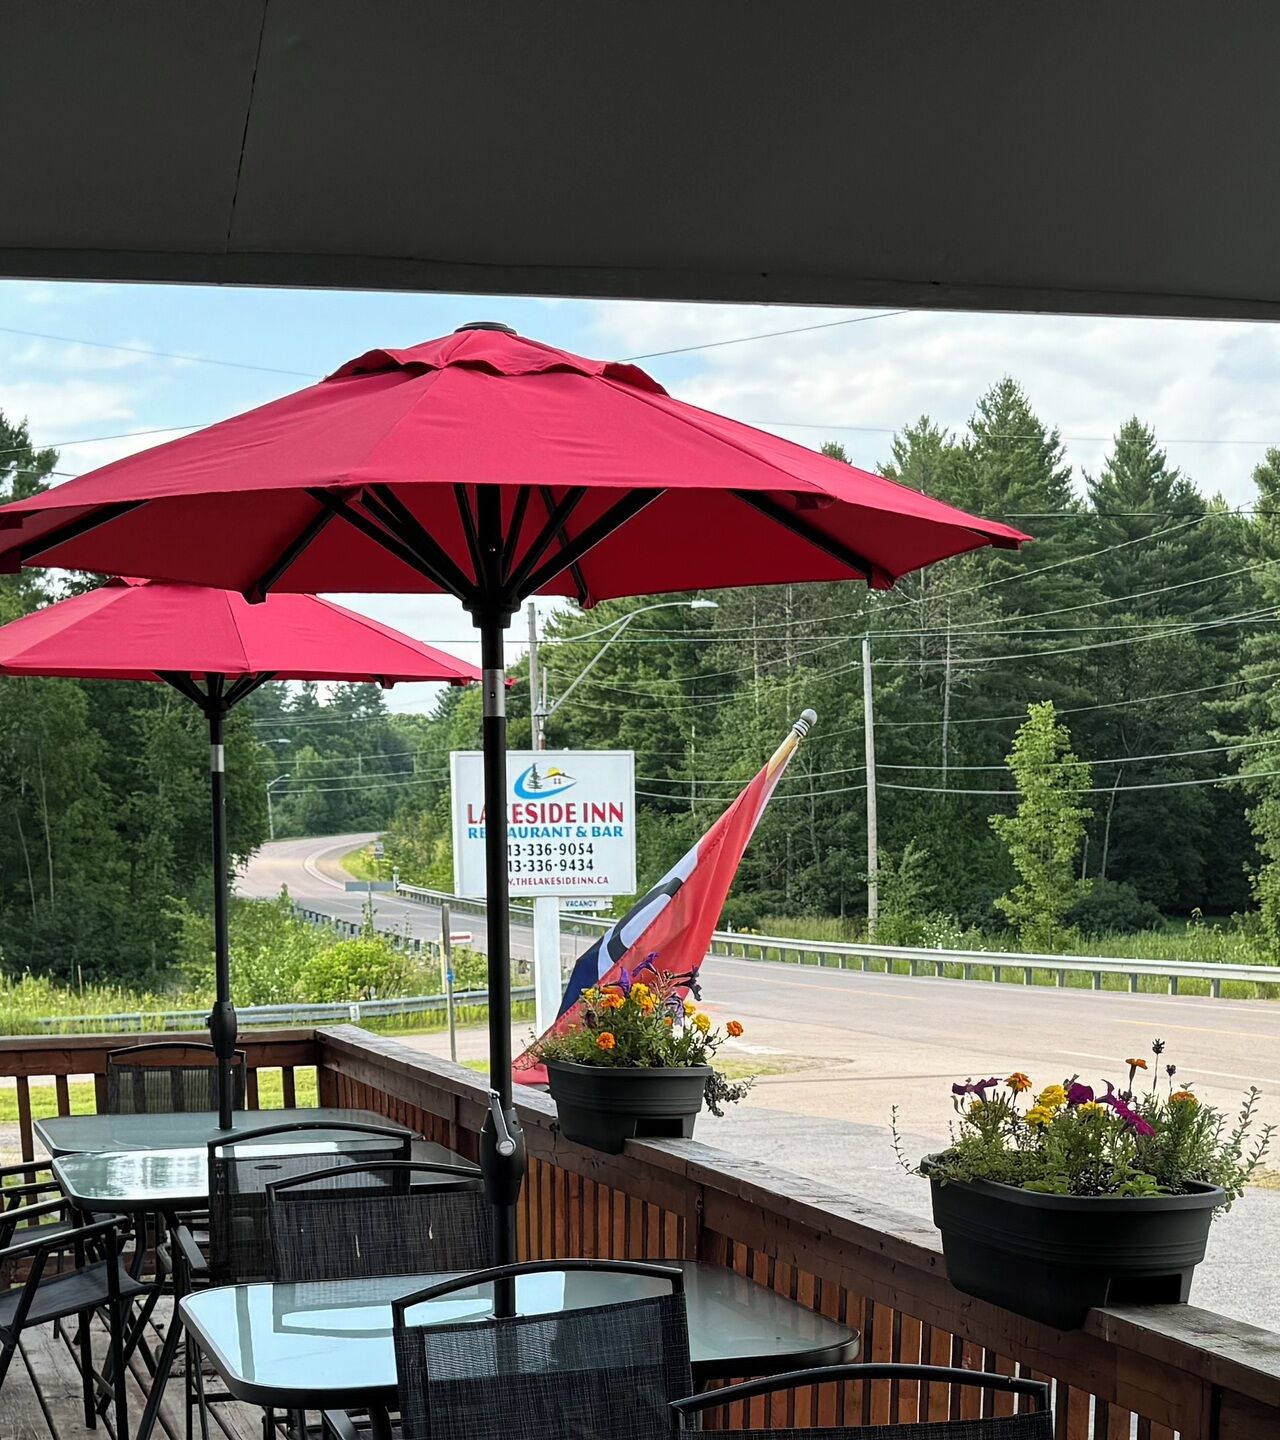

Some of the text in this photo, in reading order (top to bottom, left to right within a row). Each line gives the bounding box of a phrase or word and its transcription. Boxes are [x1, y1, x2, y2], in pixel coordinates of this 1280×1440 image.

[467, 802, 624, 824] LESIDE INN
[468, 825, 624, 839] REAURANT & BAR
[508, 843, 594, 856] 13-336-9054
[508, 858, 594, 872] 13-336-9434
[507, 876, 609, 886] .THELAKESIDEINN.CA
[565, 899, 597, 907] VACANCY
